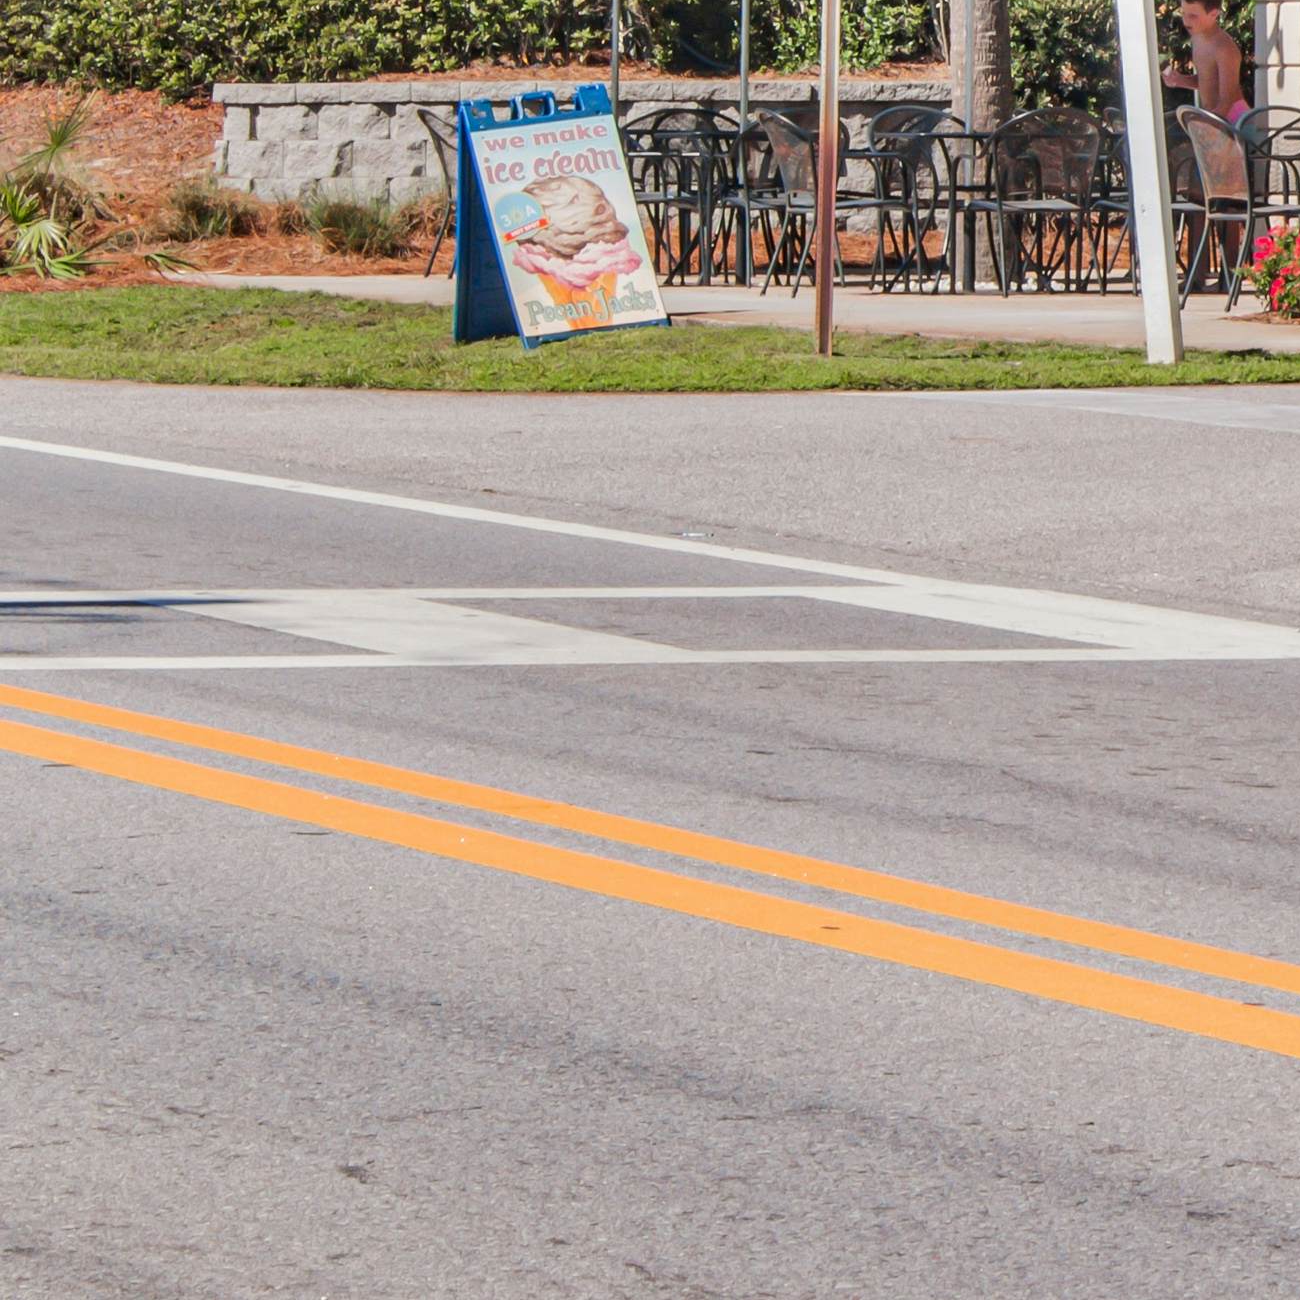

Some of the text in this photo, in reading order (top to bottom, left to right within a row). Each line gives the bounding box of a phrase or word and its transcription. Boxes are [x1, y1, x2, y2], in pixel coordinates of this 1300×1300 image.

[485, 124, 607, 152] we make
[483, 147, 621, 185] ice cream
[524, 300, 593, 326] Pecan
